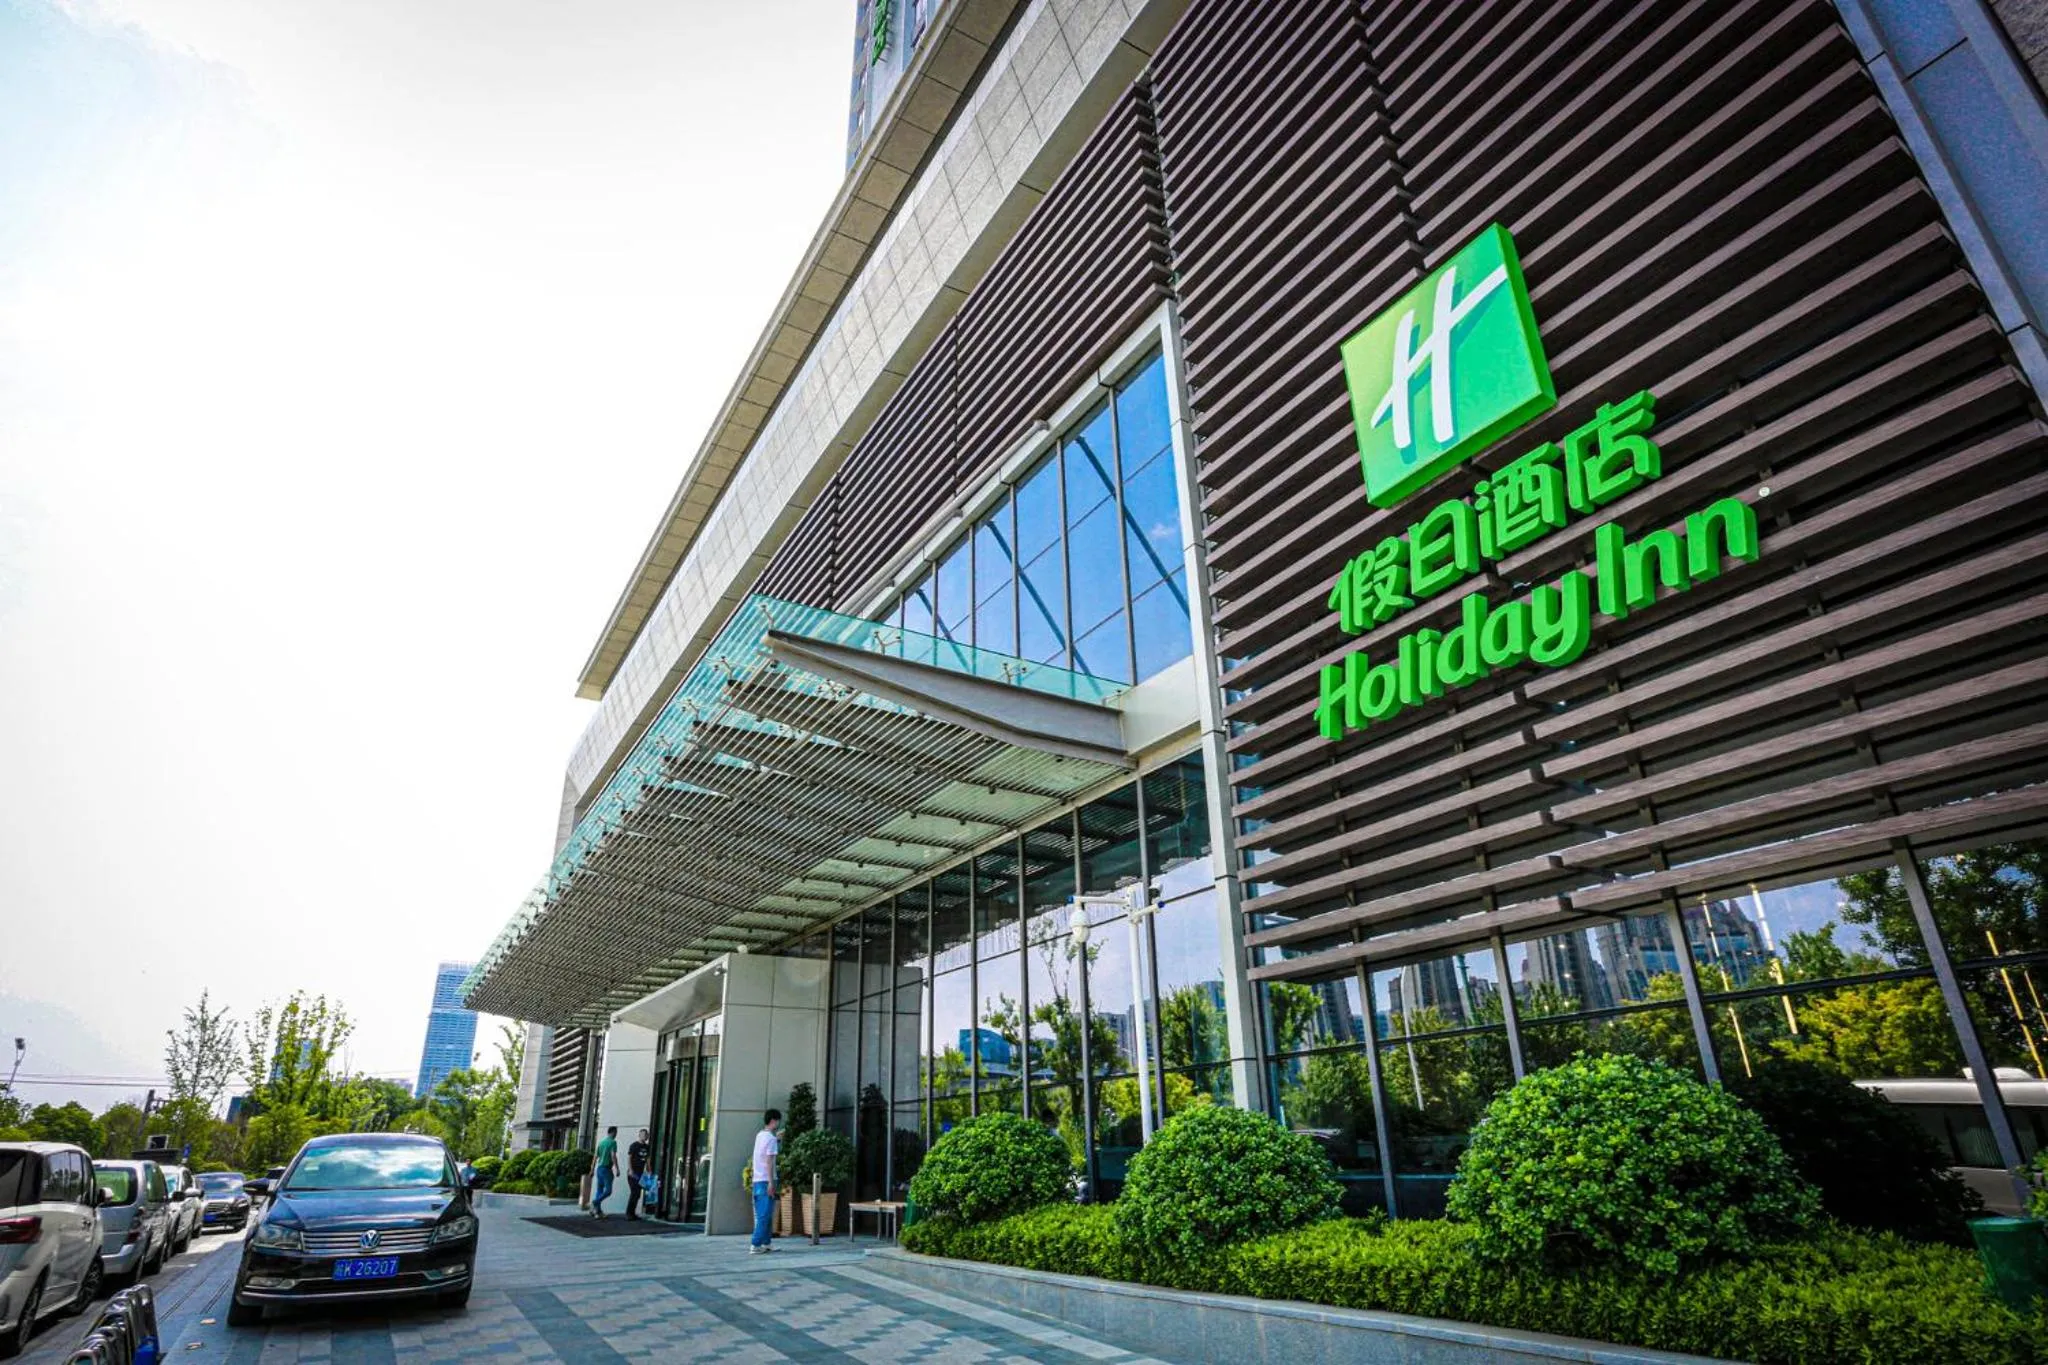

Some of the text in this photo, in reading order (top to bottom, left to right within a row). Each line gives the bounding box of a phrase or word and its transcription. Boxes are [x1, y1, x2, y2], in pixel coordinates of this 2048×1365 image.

[1314, 497, 1759, 741] Holiday Inn
[1328, 389, 1661, 635] 假日酒店
